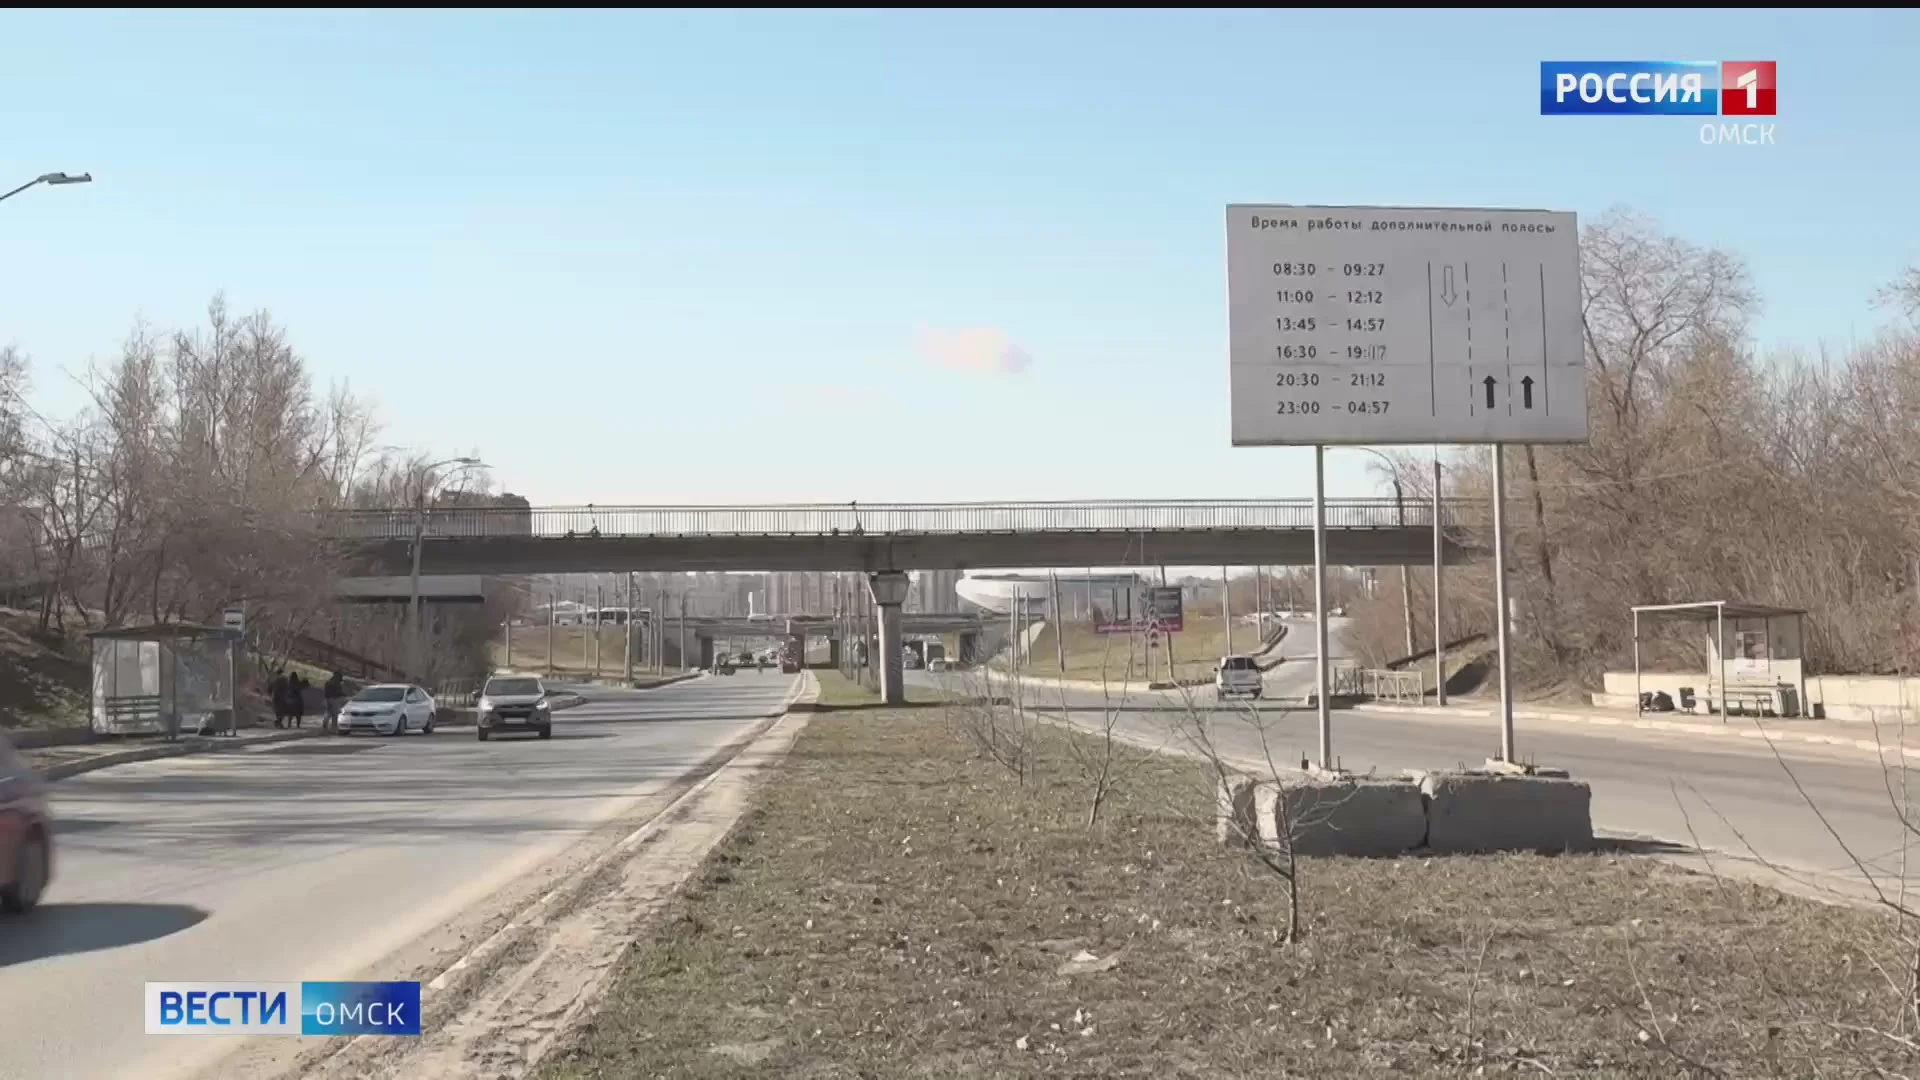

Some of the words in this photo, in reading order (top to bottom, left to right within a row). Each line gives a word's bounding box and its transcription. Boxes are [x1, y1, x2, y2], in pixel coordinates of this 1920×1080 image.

[1251, 215, 1298, 231] Время
[1308, 217, 1361, 233] работы
[1371, 219, 1493, 233] дополнительной
[1502, 223, 1556, 234] полосы
[1273, 261, 1317, 277] 08:30
[1343, 263, 1385, 277] 09:27
[1276, 289, 1315, 304] 11:00
[1347, 290, 1383, 305] 12:12
[1276, 316, 1317, 332] 13:45
[1347, 317, 1385, 332] 14:57
[1276, 344, 1317, 360] 16:30
[1276, 372, 1320, 388] 20:30
[1350, 372, 1386, 388] 21:12
[1276, 400, 1321, 415] 23:00
[1348, 400, 1391, 415] 04:57
